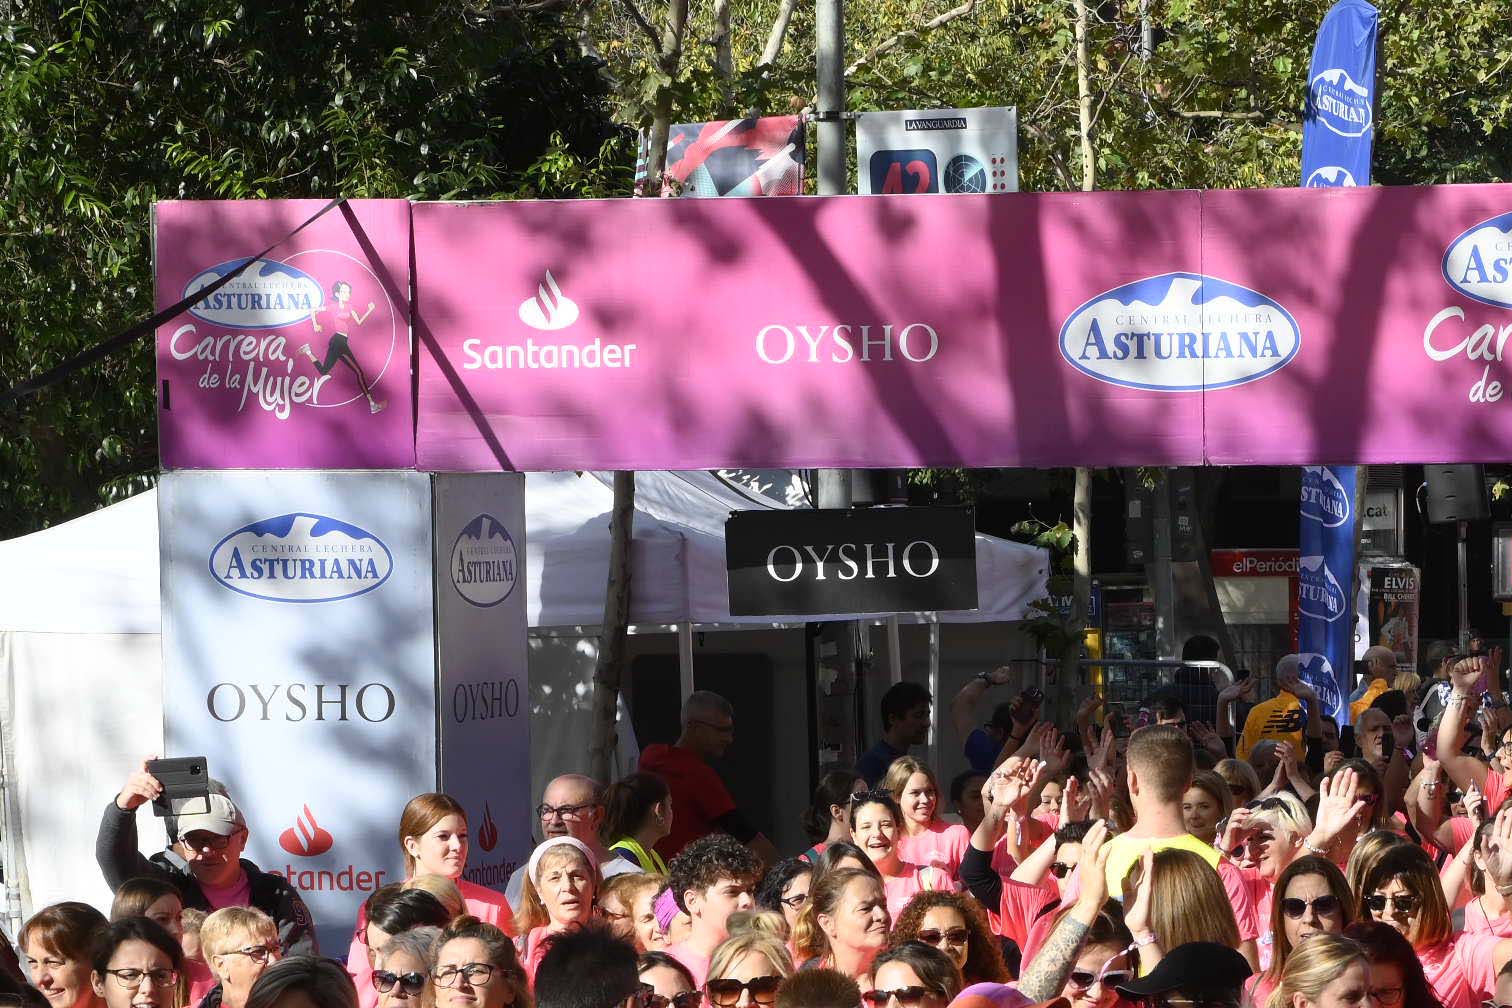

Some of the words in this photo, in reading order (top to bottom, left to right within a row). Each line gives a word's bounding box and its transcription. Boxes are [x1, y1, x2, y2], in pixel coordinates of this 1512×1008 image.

[193, 283, 312, 311] ASTURIANA
[1115, 314, 1188, 325] CENTRAL
[170, 324, 287, 361] Carrera
[463, 338, 637, 370] Santander
[755, 323, 938, 364] OYSHO
[1078, 316, 1282, 361] ASTURIANA
[199, 362, 221, 388] de
[225, 362, 241, 388] la
[239, 358, 332, 420] Mujer
[1468, 365, 1504, 404] de
[224, 546, 380, 580] ASTURIANA
[252, 544, 310, 553] CENTRAL
[456, 548, 514, 584] ASTURIANA
[767, 540, 940, 582] OYSHO
[1233, 556, 1300, 573] elPeriódi
[207, 682, 396, 723] OYSHO
[453, 678, 520, 723] OYSHO
[267, 864, 386, 892] tander
